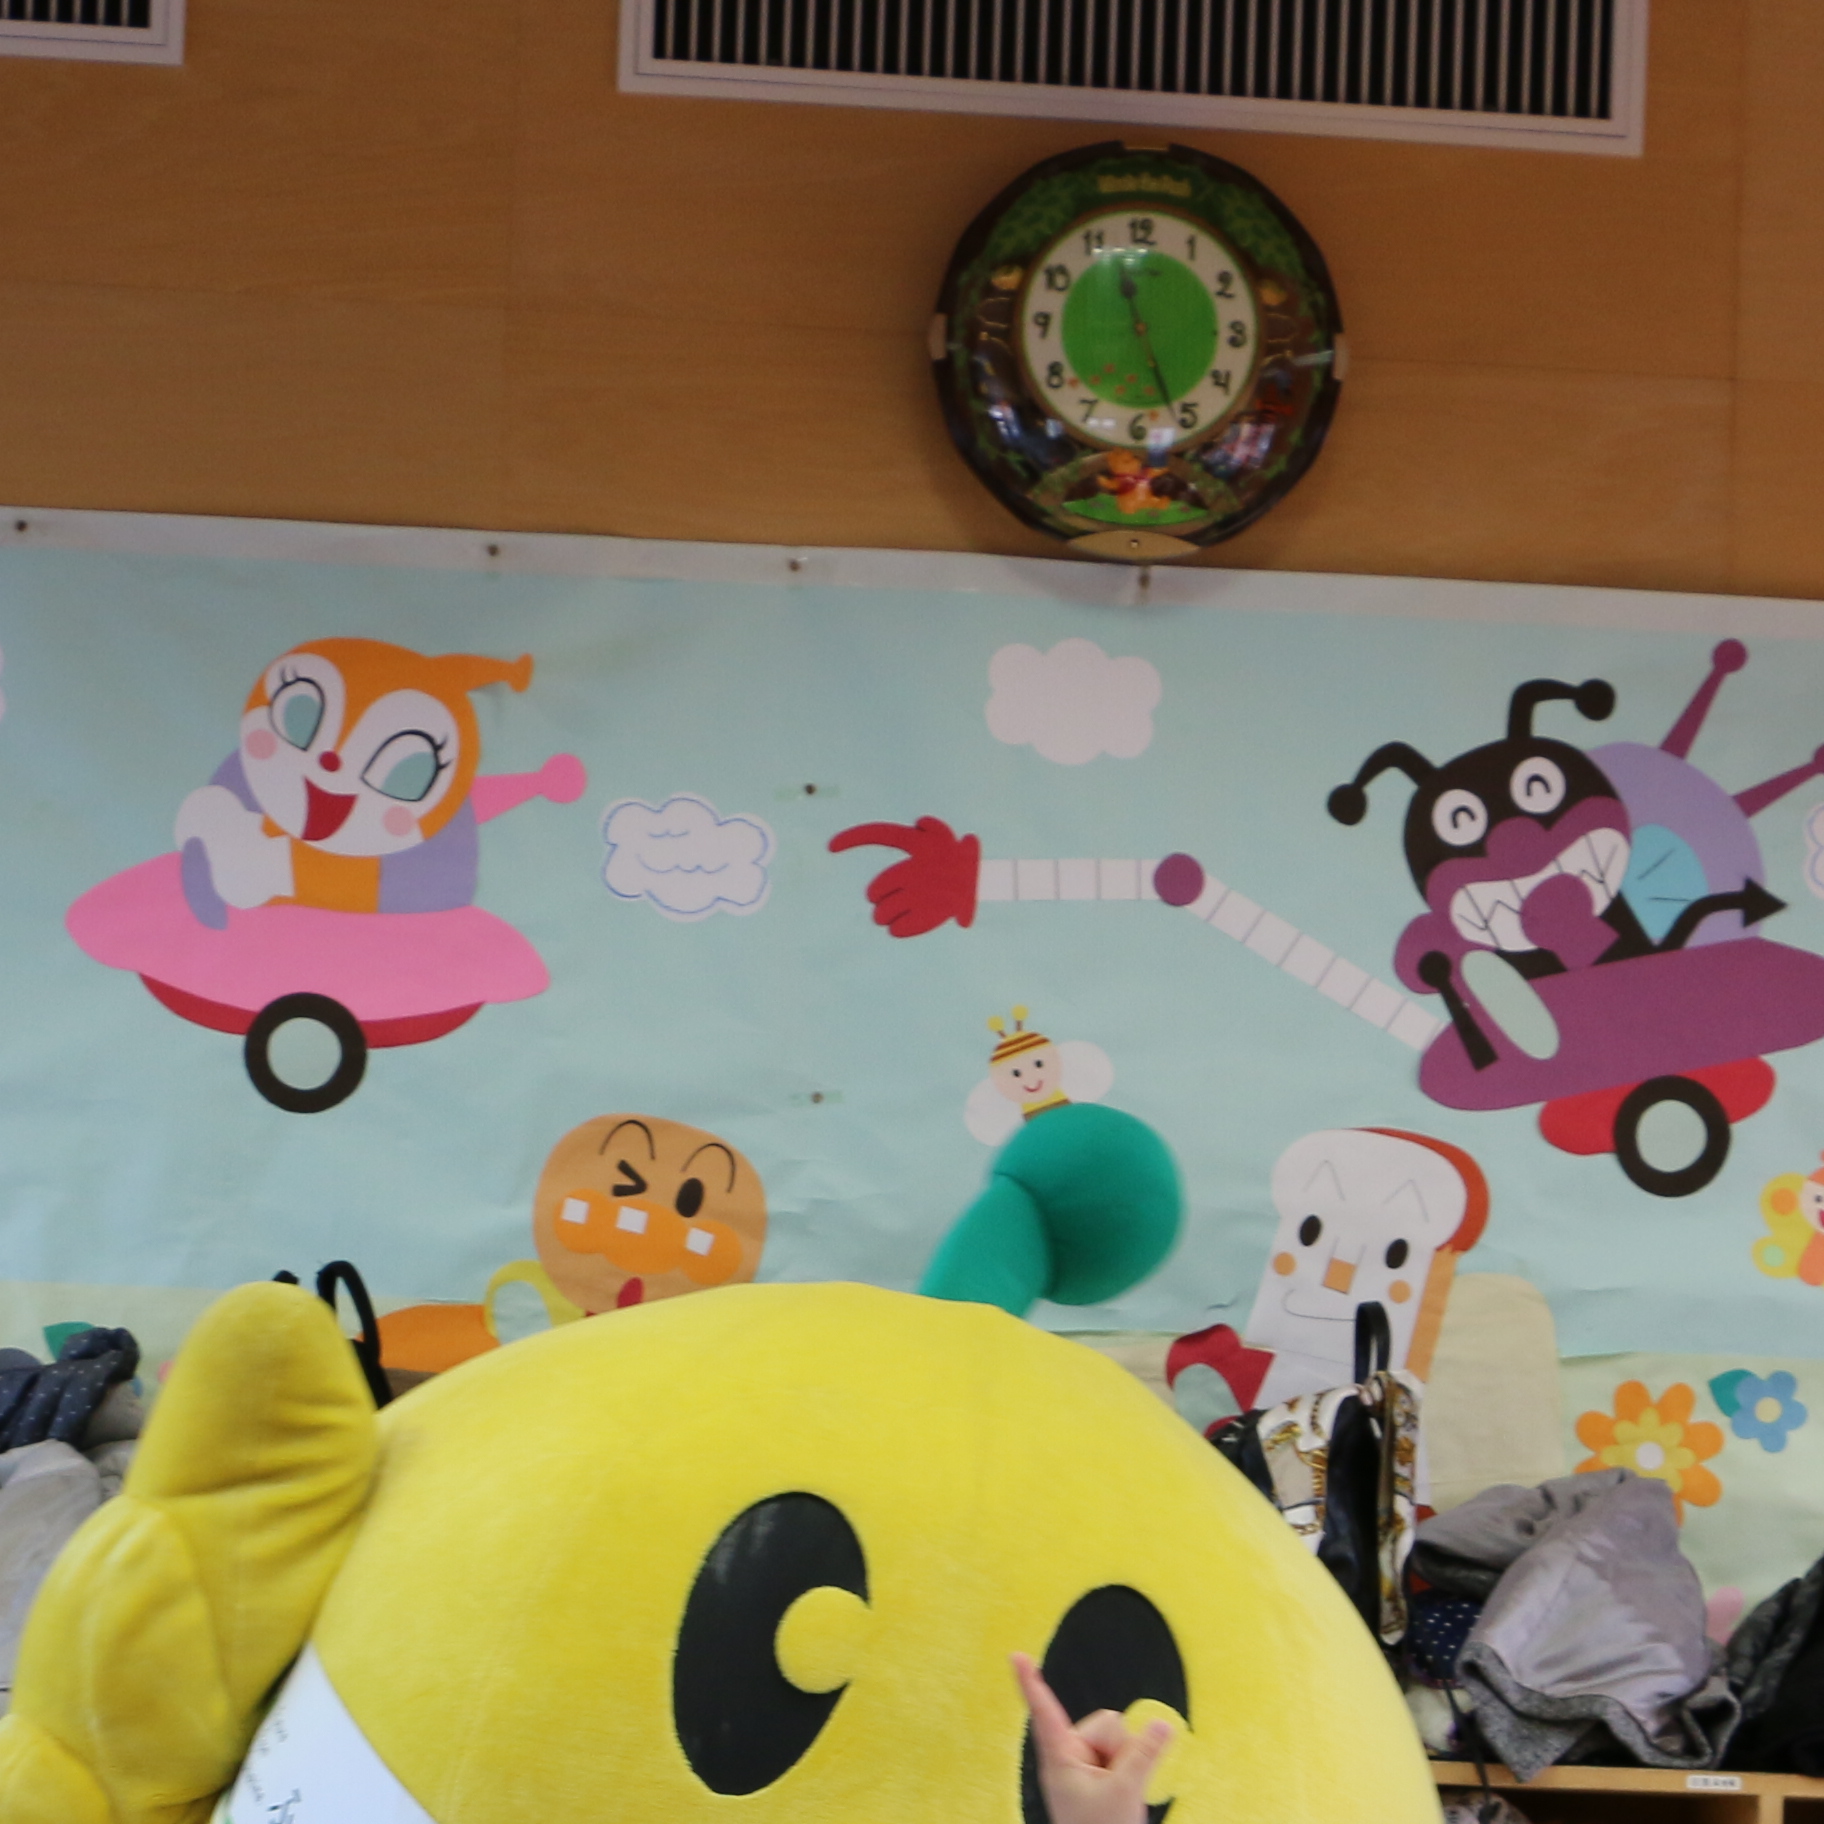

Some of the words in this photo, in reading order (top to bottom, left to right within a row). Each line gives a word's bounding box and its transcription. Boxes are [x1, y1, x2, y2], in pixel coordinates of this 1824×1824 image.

[1083, 230, 1105, 254] 11
[1128, 218, 1157, 247] 12
[1045, 264, 1072, 292] 10
[1215, 271, 1236, 298] 2
[1033, 312, 1053, 338] 9
[1228, 322, 1248, 347] 3
[1045, 362, 1064, 390] 8
[1211, 370, 1231, 394] 4
[1079, 399, 1098, 424] 7
[1179, 402, 1199, 428] 5
[1128, 413, 1146, 441] 6
